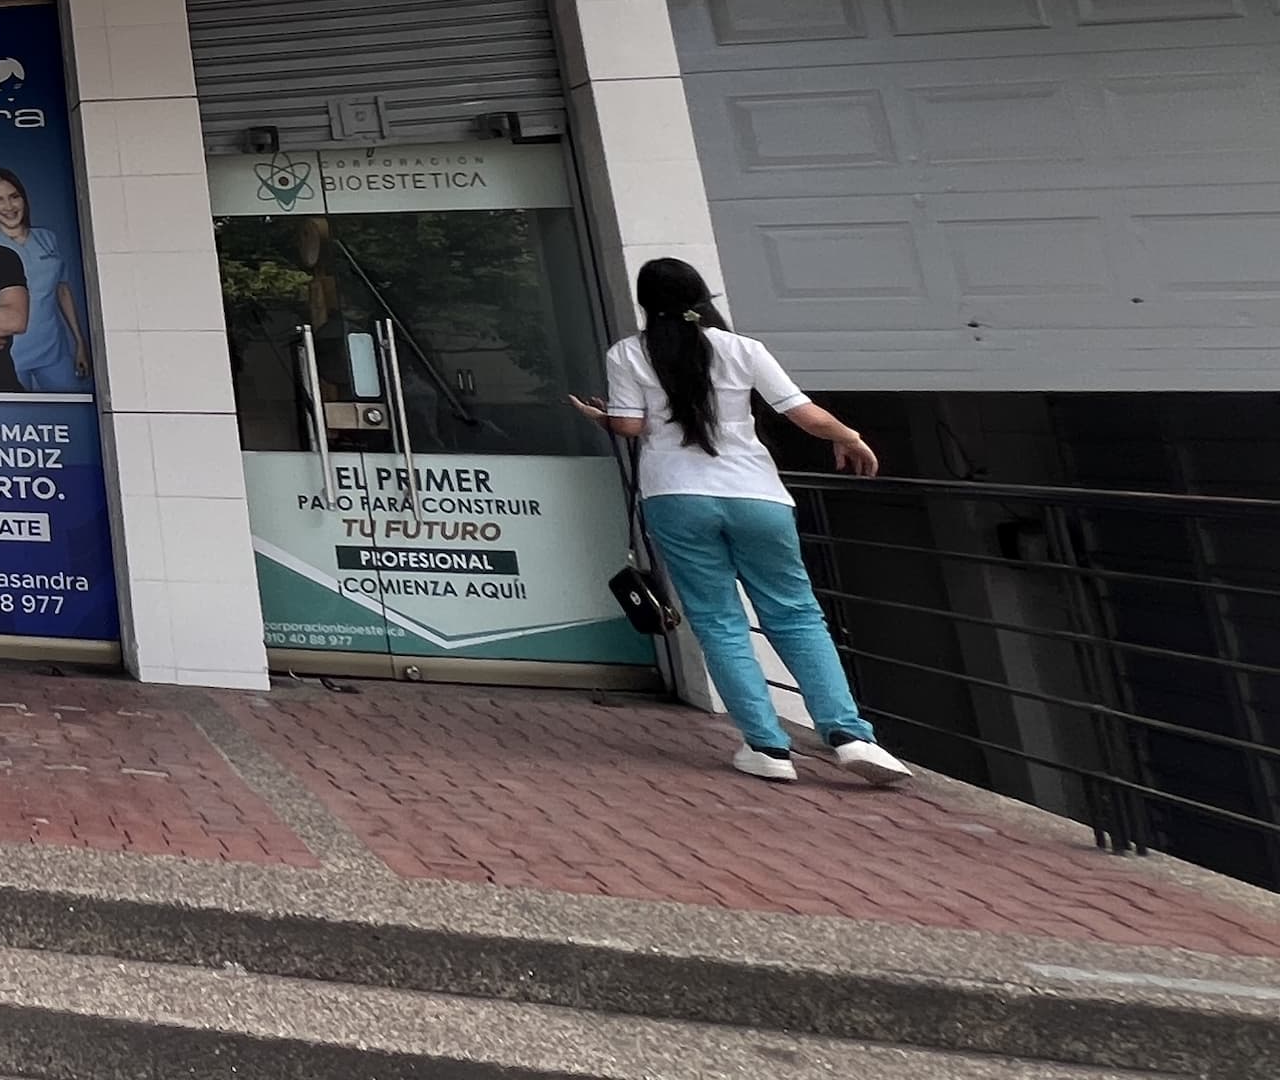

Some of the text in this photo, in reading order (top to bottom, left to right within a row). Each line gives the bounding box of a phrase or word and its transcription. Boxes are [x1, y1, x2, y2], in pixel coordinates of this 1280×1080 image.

[322, 171, 487, 192] BIOESTETICA
[336, 466, 493, 494] EL PRIMER
[297, 494, 353, 512] PAO
[421, 497, 542, 516] CONSTRUIR
[342, 518, 502, 541] TU FUTURO
[465, 578, 528, 600] AQUÍ!
[21, 594, 64, 615] 977
